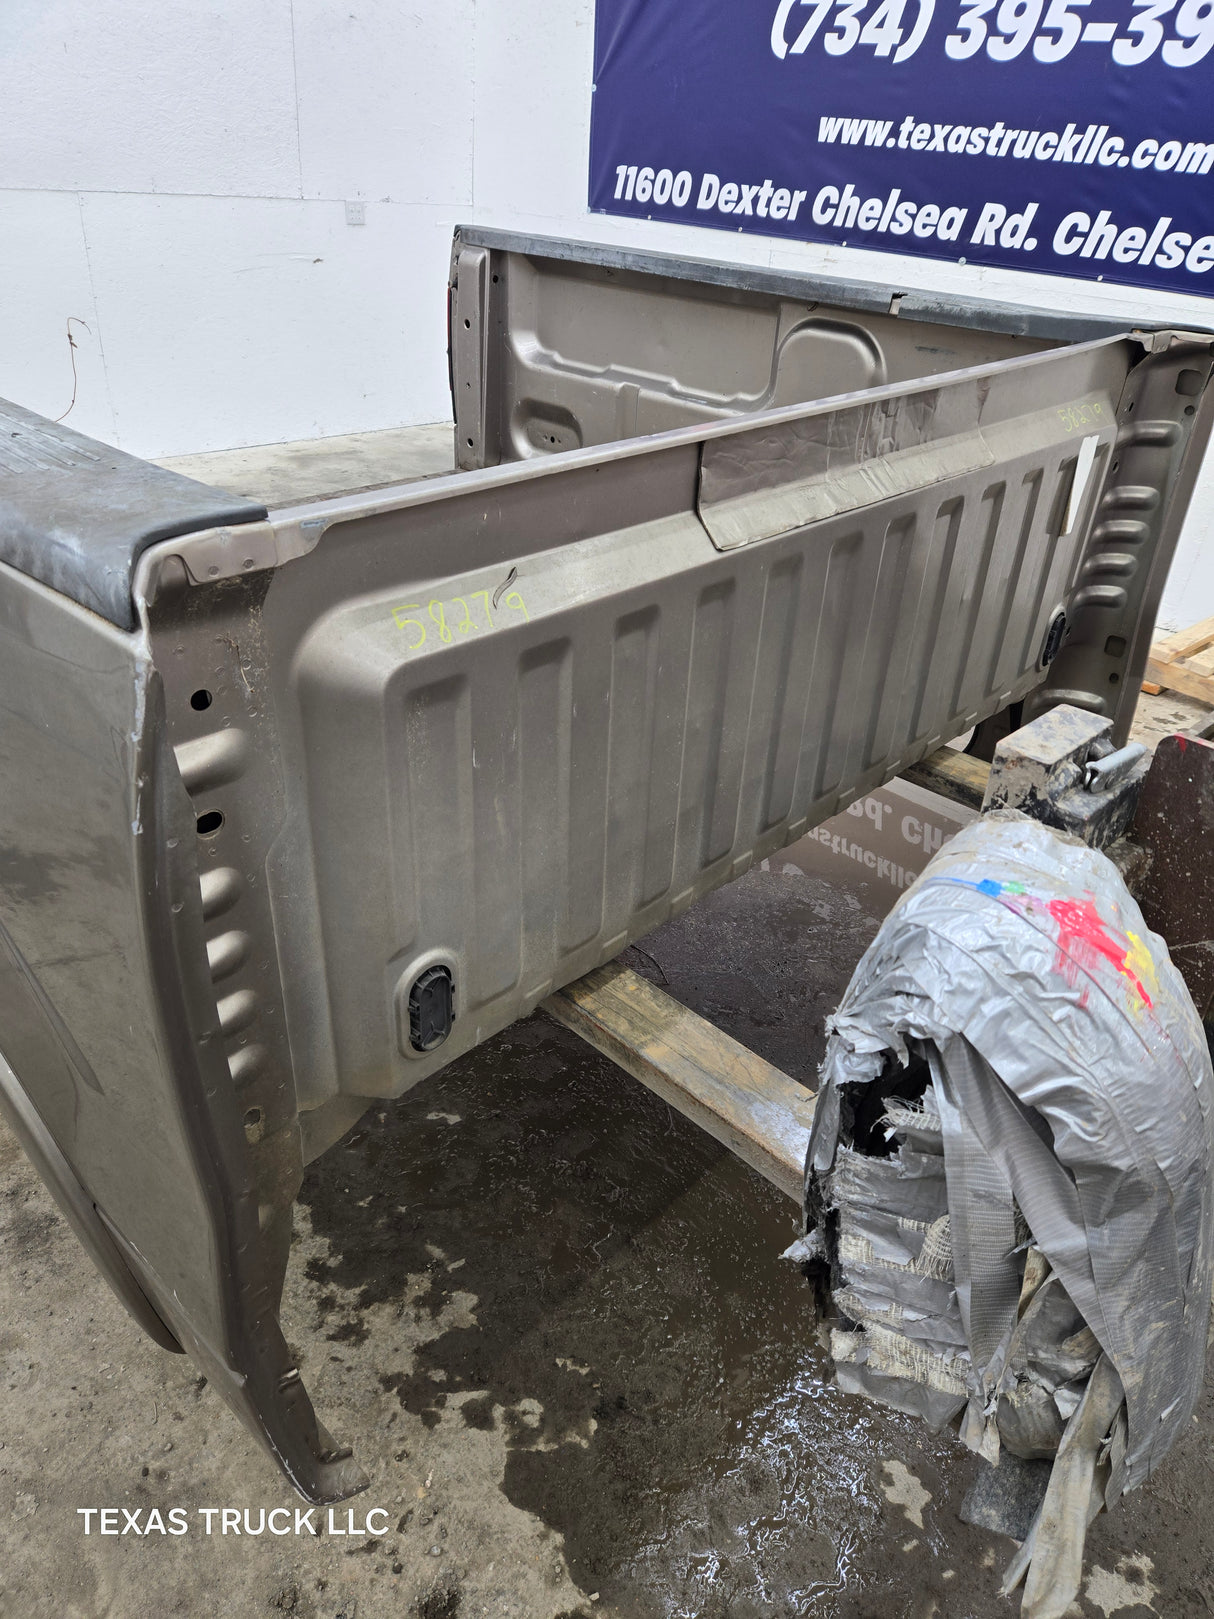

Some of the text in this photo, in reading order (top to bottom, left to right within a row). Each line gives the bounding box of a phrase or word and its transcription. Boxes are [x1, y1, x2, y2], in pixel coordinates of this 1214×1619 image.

[770, 0, 1214, 68] (734) 395-39
[817, 115, 1214, 175] www.texastruckllc.com
[613, 164, 1214, 274] 11600 Dexter Chelsea Rd. Chelse
[391, 590, 531, 650] 58279
